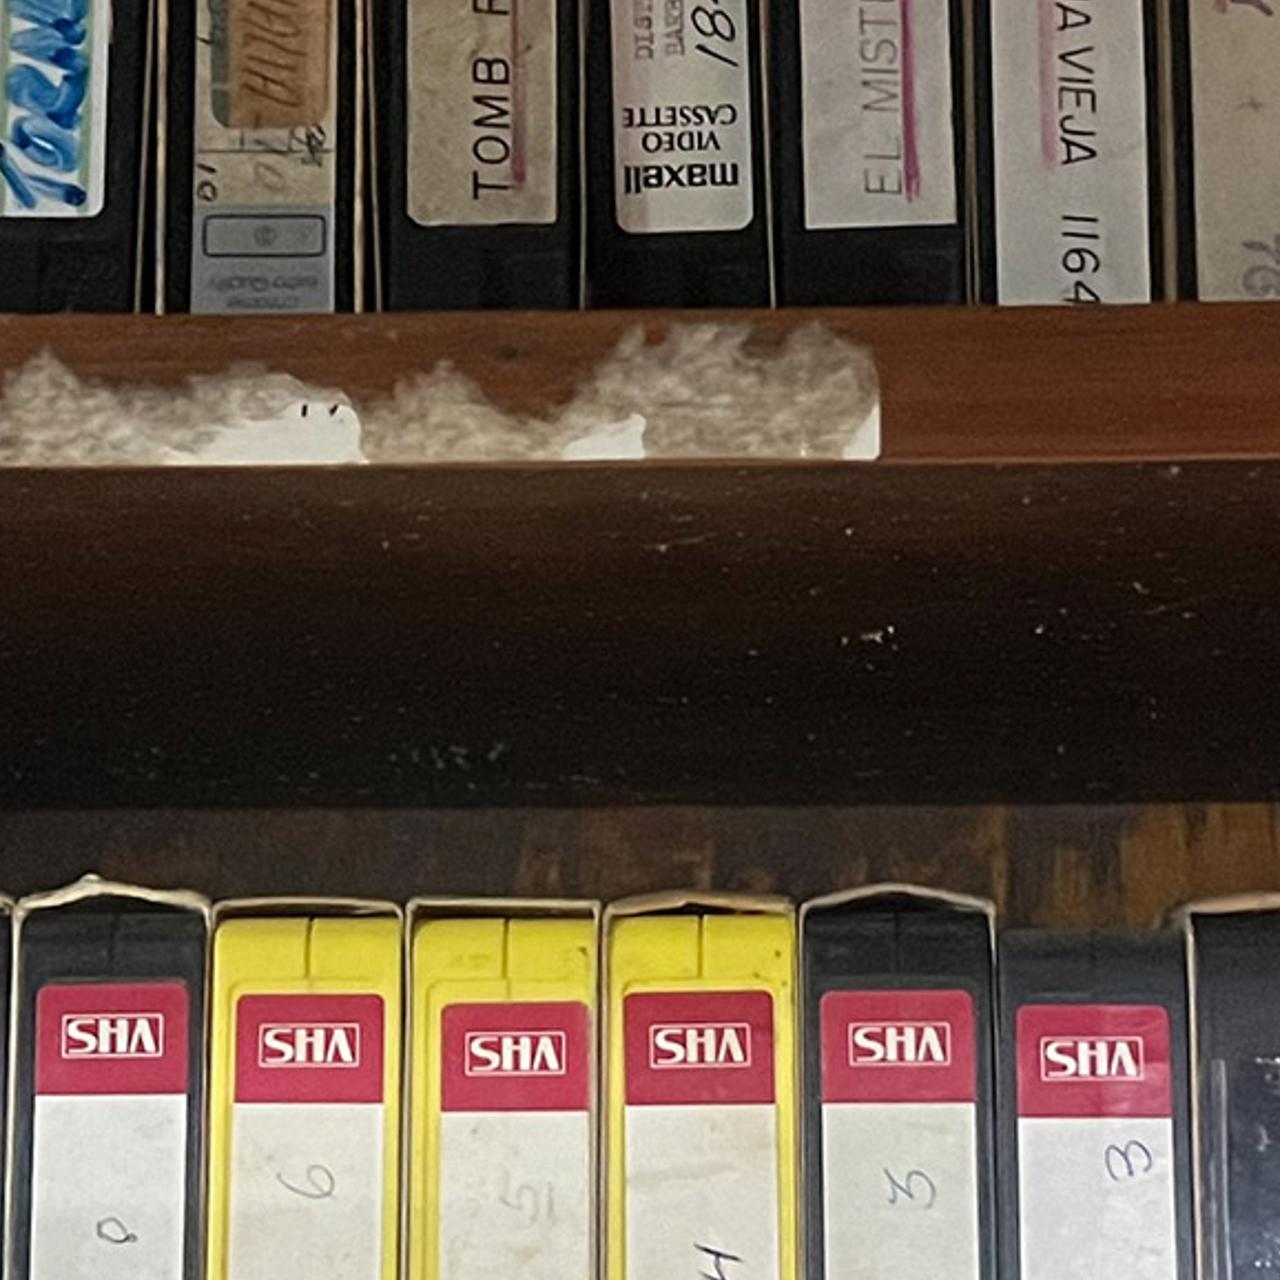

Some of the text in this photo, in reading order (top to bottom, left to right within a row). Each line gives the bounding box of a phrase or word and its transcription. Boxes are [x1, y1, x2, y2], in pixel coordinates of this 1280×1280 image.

[622, 105, 738, 128] CASSETTE
[1056, 45, 1098, 168] VIEJA
[472, 56, 512, 201] TOMB
[641, 130, 721, 154] VIDEO
[623, 163, 739, 196] maxell
[864, 139, 903, 198] EL
[64, 1017, 160, 1056] VHS
[262, 1026, 356, 1064] VHS
[468, 1034, 562, 1073] VHS
[652, 1027, 748, 1065] VHS
[851, 1025, 947, 1063] VHS
[1044, 1039, 1142, 1078] VHS
